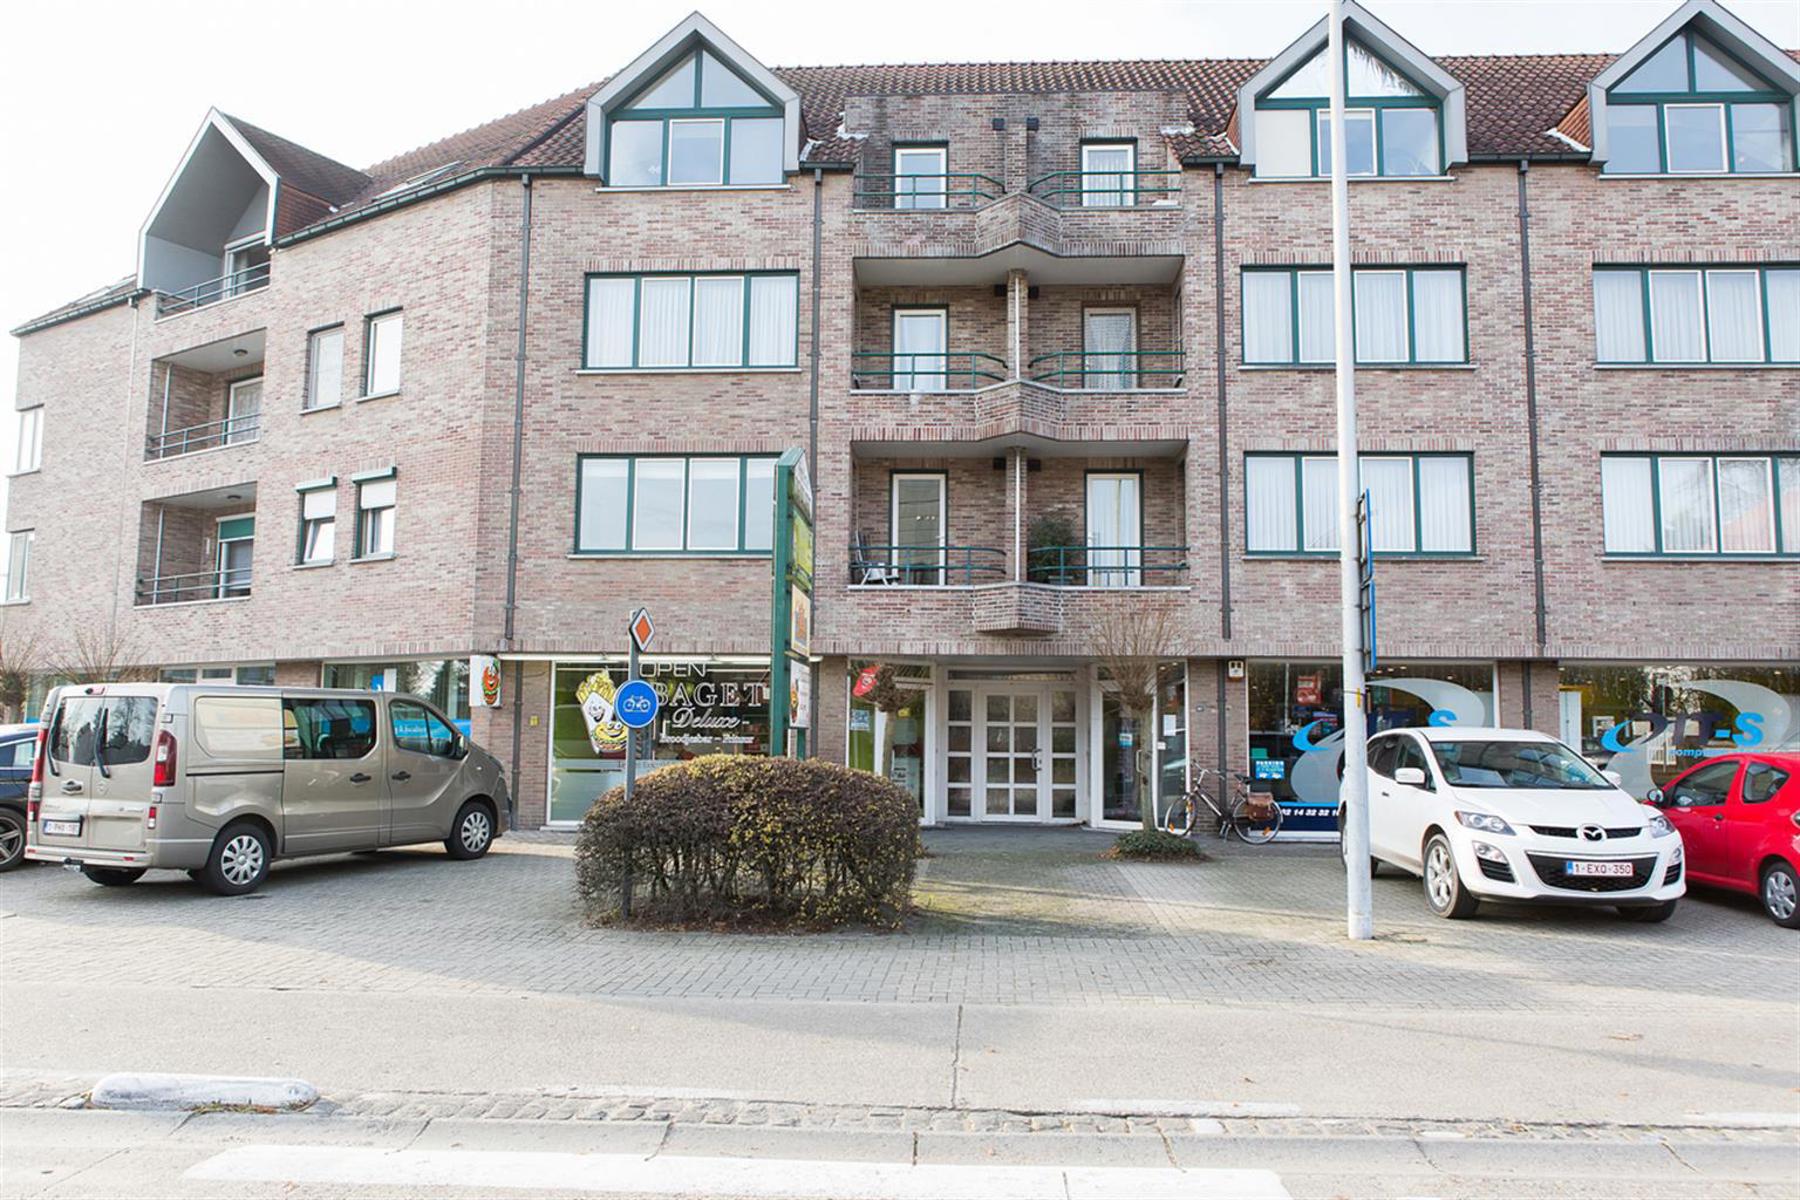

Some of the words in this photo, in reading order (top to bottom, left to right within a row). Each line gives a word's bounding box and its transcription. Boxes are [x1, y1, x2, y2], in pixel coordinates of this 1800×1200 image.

[639, 661, 707, 678] OPEN
[652, 681, 765, 707] BAGET
[672, 707, 741, 729] Deluxe
[1294, 808, 1304, 816] 14
